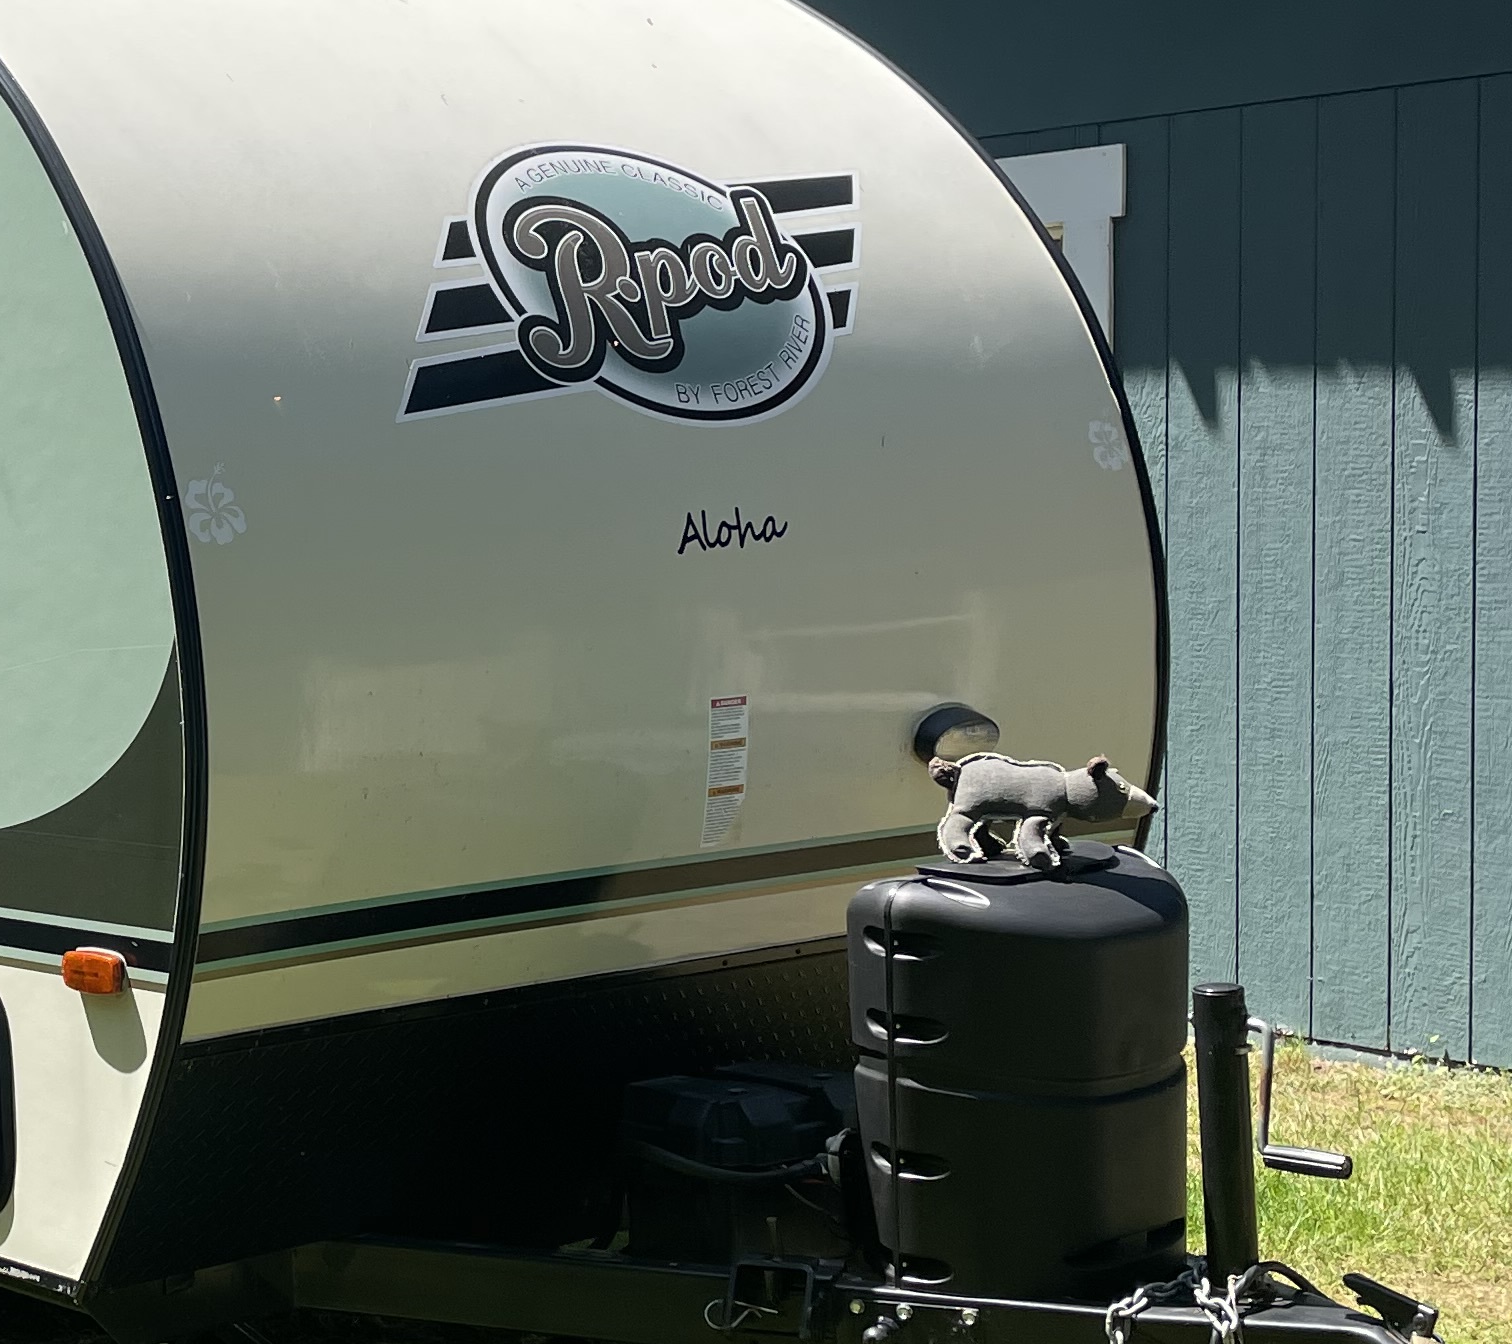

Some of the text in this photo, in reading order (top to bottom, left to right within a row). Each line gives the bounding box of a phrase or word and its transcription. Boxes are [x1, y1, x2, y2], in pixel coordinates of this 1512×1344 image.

[514, 159, 724, 210] A GENUINE CLASSIC
[675, 314, 811, 405] BY FOREST RIVER
[677, 506, 788, 555] Aloha
